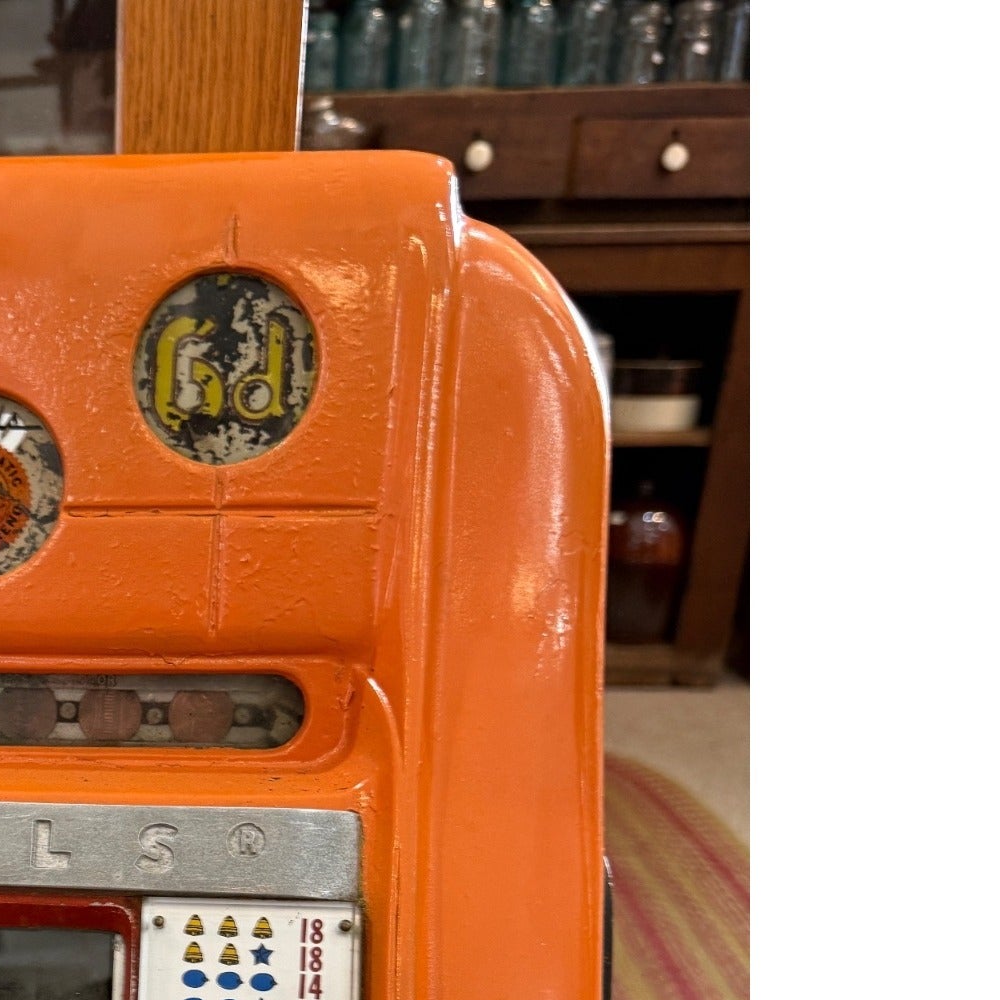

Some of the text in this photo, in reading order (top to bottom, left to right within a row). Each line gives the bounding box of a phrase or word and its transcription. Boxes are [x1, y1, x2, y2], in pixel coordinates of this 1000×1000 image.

[153, 315, 286, 433] 6d
[300, 918, 324, 944] 18
[299, 946, 323, 972] 18
[298, 974, 323, 999] 14
